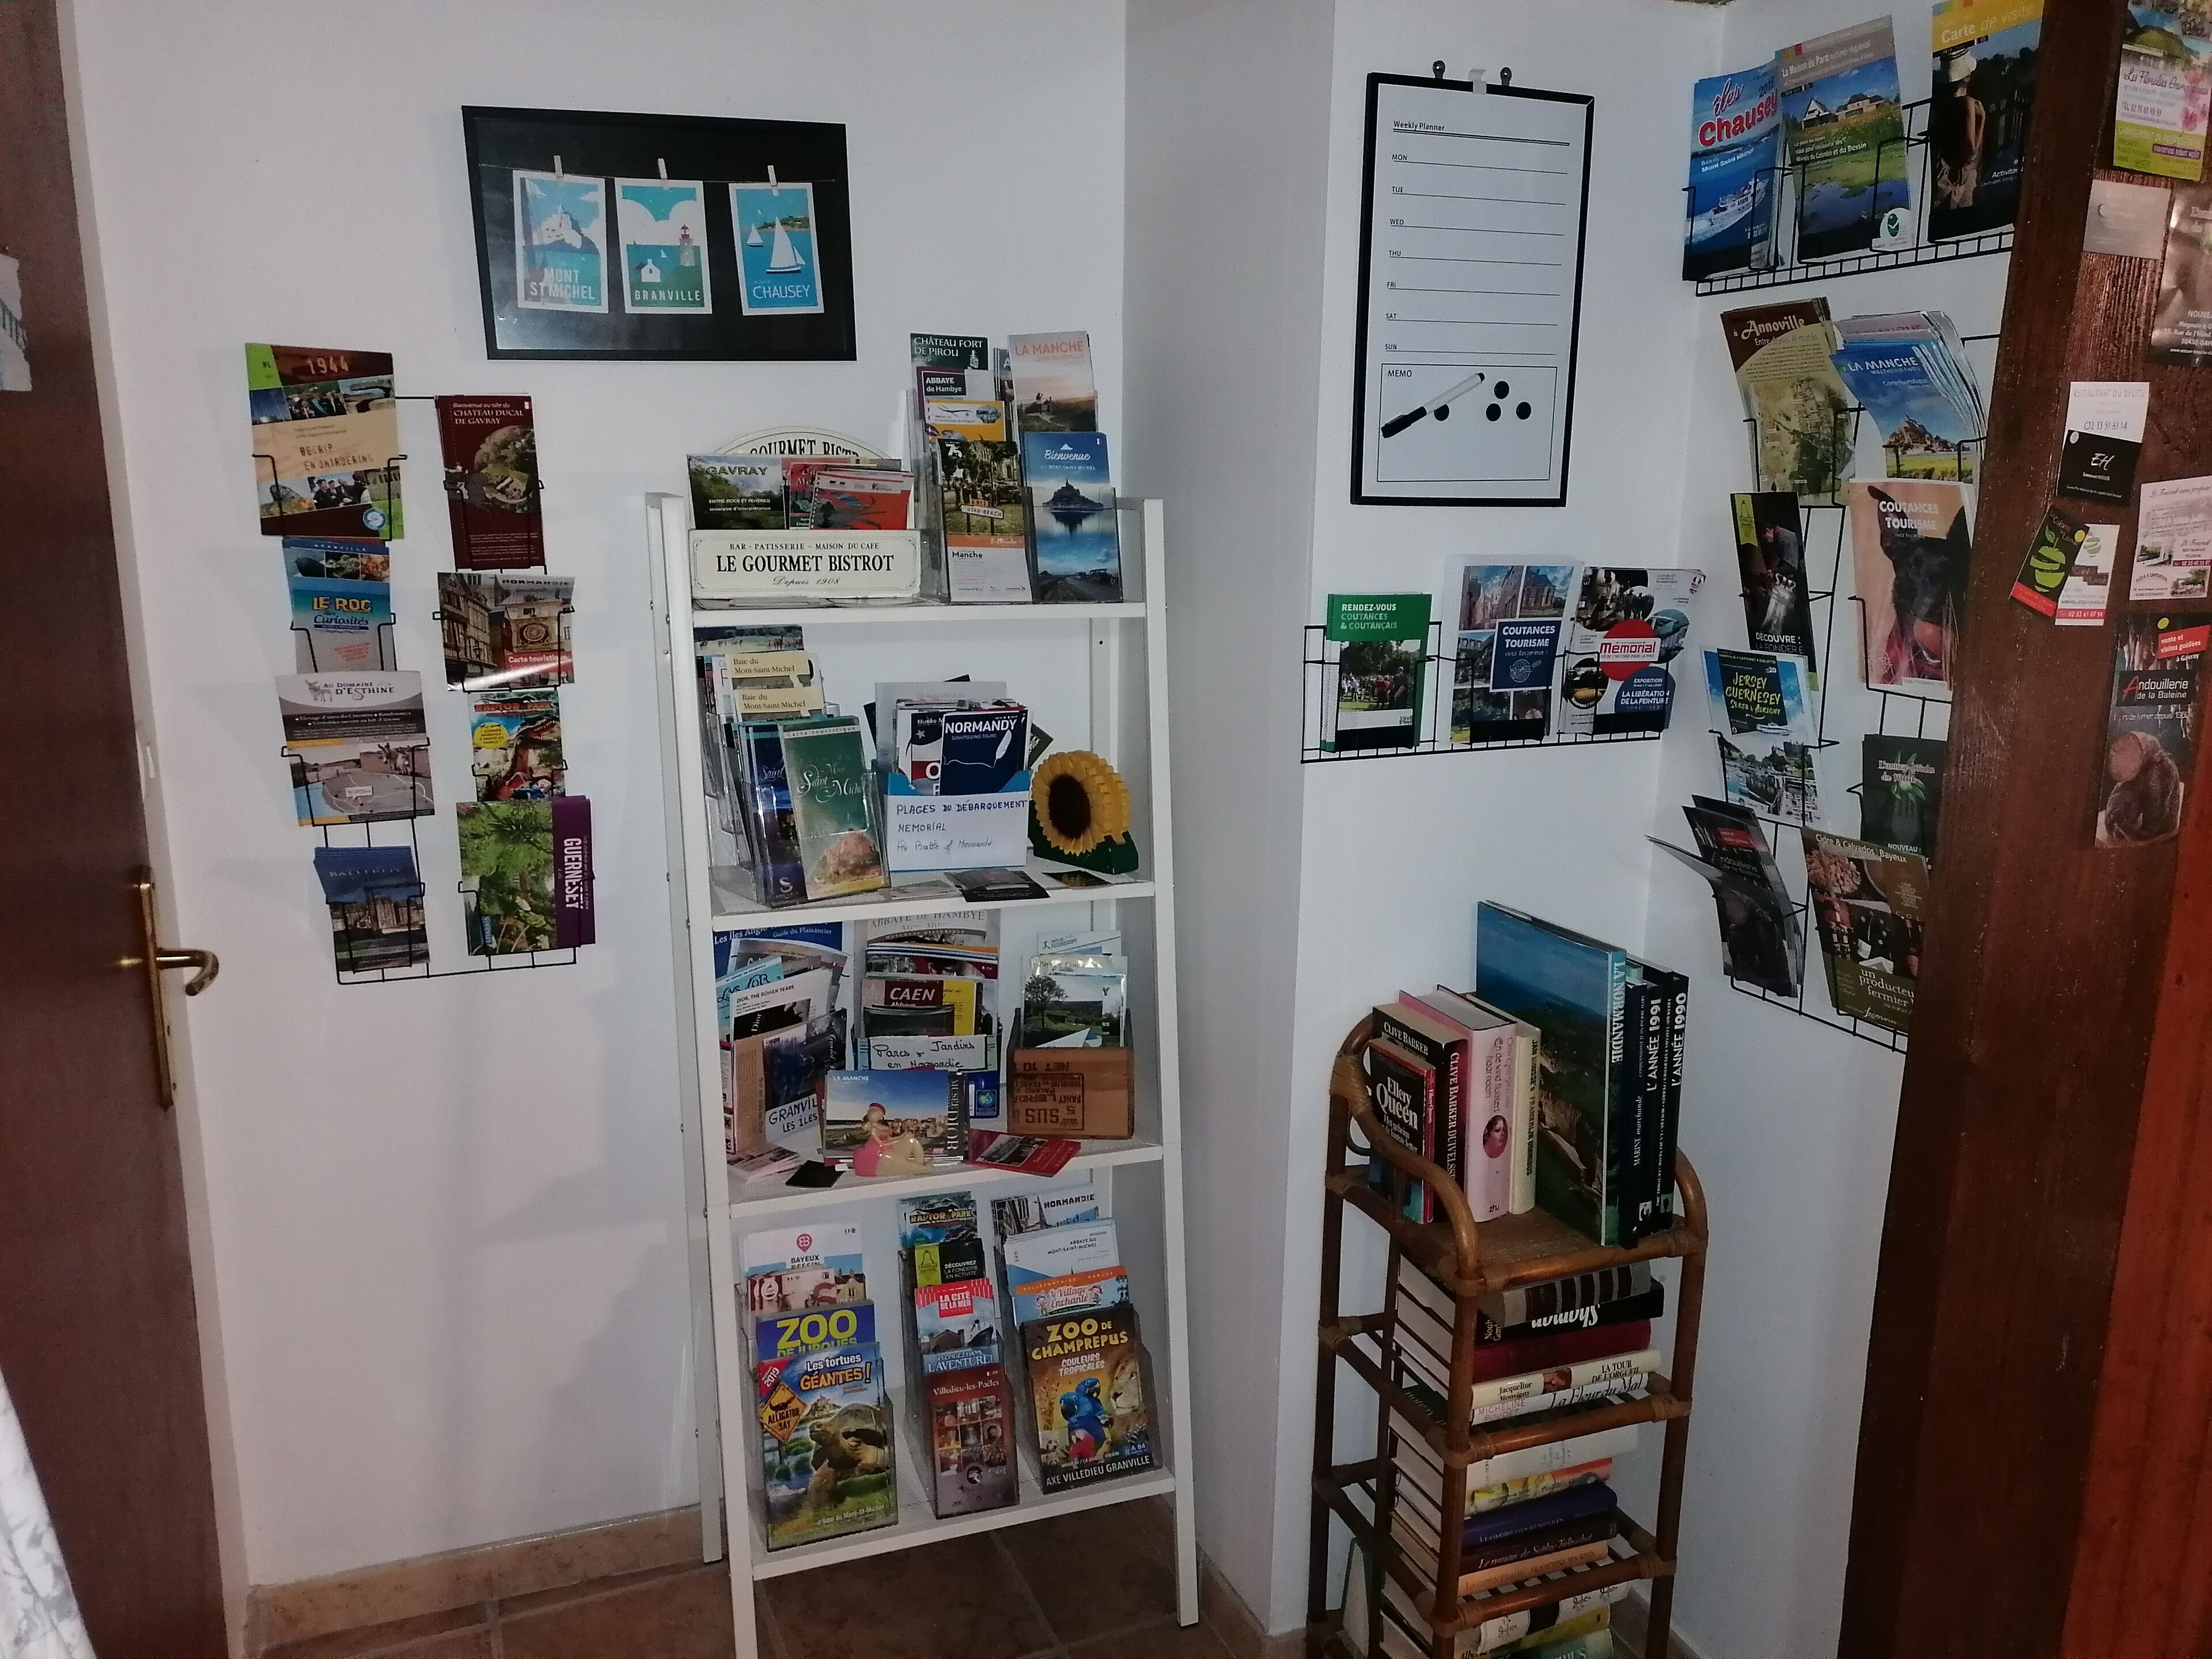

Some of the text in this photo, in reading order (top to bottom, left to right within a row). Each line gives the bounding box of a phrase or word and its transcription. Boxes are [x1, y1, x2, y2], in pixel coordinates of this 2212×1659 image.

[1942, 5, 2033, 43] Carte de visite
[1816, 54, 1830, 66] Parc
[1699, 89, 1778, 146] Chausey
[1393, 120, 1445, 131] Weekly Planner
[1848, 141, 1866, 152] Bessin
[544, 268, 579, 283] MONT
[635, 290, 700, 301] GRANVILLE
[753, 285, 810, 299] CHAUSEY
[1741, 316, 1804, 340] Annoville
[914, 336, 983, 348] CHÂTEAU FORT
[1015, 340, 1083, 355] LA MANCHE
[929, 348, 959, 357] PIROU
[306, 355, 349, 374] 1944
[1847, 363, 1862, 372] LA
[1865, 357, 1918, 370] MANCHE
[926, 377, 955, 385] ABBAYE
[2113, 389, 2121, 397] DU
[2084, 422, 2094, 430] 02
[1044, 449, 1090, 460] Bienvenue
[706, 465, 768, 476] GAVRAY
[1879, 501, 1939, 514] COUTANCES
[1885, 517, 1937, 530] TOURISME
[952, 550, 983, 558] Manche
[716, 554, 894, 572] LE GOURMET BISTROT
[772, 576, 809, 587] Depuis
[313, 596, 372, 613] LE ROC
[1342, 603, 1397, 612] RENDEZ-VOUS
[314, 615, 369, 625] Curiosités
[1349, 622, 1397, 631] COUTANÇAIS
[1502, 626, 1555, 635] COUTANCES
[1505, 639, 1550, 648] TOURISME
[2160, 640, 2202, 653] visites guidées
[2161, 636, 2177, 645] vente
[509, 655, 528, 664] Carte
[735, 665, 795, 674] Mont-Saint-Michel
[1733, 672, 1767, 690] JERSEY
[2123, 675, 2188, 701] Andouillerie
[336, 687, 395, 700] D'ESTHINE
[1725, 686, 1781, 705] GUERNESEY
[2158, 691, 2187, 699] Baleine
[744, 700, 806, 709] Mont-Saint-Michel
[945, 719, 1017, 734] NORMANDY
[897, 800, 1028, 815] PLAGES DÉBARQUEMENT
[915, 840, 940, 851] Battle
[1816, 834, 1908, 863] Cidre & Calvados Bayeux
[1888, 843, 1917, 853] NOUVEAU
[564, 838, 584, 910] GUERNESEY
[799, 927, 832, 936] Plaisancier
[714, 935, 727, 945] Les
[1861, 969, 1876, 979] un
[889, 987, 935, 1001] CAEN
[1868, 985, 1908, 1007] fermier
[1612, 961, 1626, 1063] LA NORMANDIE
[1649, 998, 1662, 1032] 1991
[1673, 992, 1687, 1030] 1990
[751, 1013, 762, 1032] Dior
[1384, 1021, 1429, 1055] CLIVE BARKER
[872, 1040, 975, 1058] Parcs Jardins
[1672, 1033, 1686, 1087] L'ANNÉE
[1387, 1076, 1411, 1107] Ellery
[1448, 1052, 1460, 1130] CLIVE BARKER
[1376, 1083, 1418, 1130] Queen
[783, 1121, 796, 1132] LES
[947, 1110, 960, 1150] DIOR
[1634, 1135, 1642, 1166] MARINE
[1044, 1194, 1094, 1209] NORMANDIE
[911, 1210, 974, 1223] RAPTOR PARK
[791, 1254, 820, 1264] BAYEUX
[945, 1260, 976, 1268] DÉCOUVREZ
[940, 1290, 970, 1303] LA CITÉ
[1057, 1286, 1086, 1297] Village
[941, 1298, 971, 1310] DE LA MER
[1051, 1292, 1089, 1309] Enchanté
[777, 1309, 857, 1349] ZOO
[1047, 1318, 1112, 1343] ZOO DE
[1032, 1331, 1128, 1361] CHAMPREPUS
[806, 1353, 862, 1372] Les tortues
[1061, 1353, 1101, 1368] COULEURS
[1602, 1359, 1633, 1374] LA TOUR
[1059, 1360, 1105, 1377] TROPICALES
[764, 1367, 781, 1388] 2019
[800, 1366, 863, 1391] GÉANTES
[1498, 1382, 1533, 1396] Jacqueline
[1479, 1400, 1525, 1415] MICHELINE
[768, 1407, 801, 1425] ALLIGATOR
[1046, 1475, 1062, 1487] AXE
[1062, 1465, 1104, 1483] VILLEDIEU
[1105, 1455, 1151, 1474] GRANVILLE
